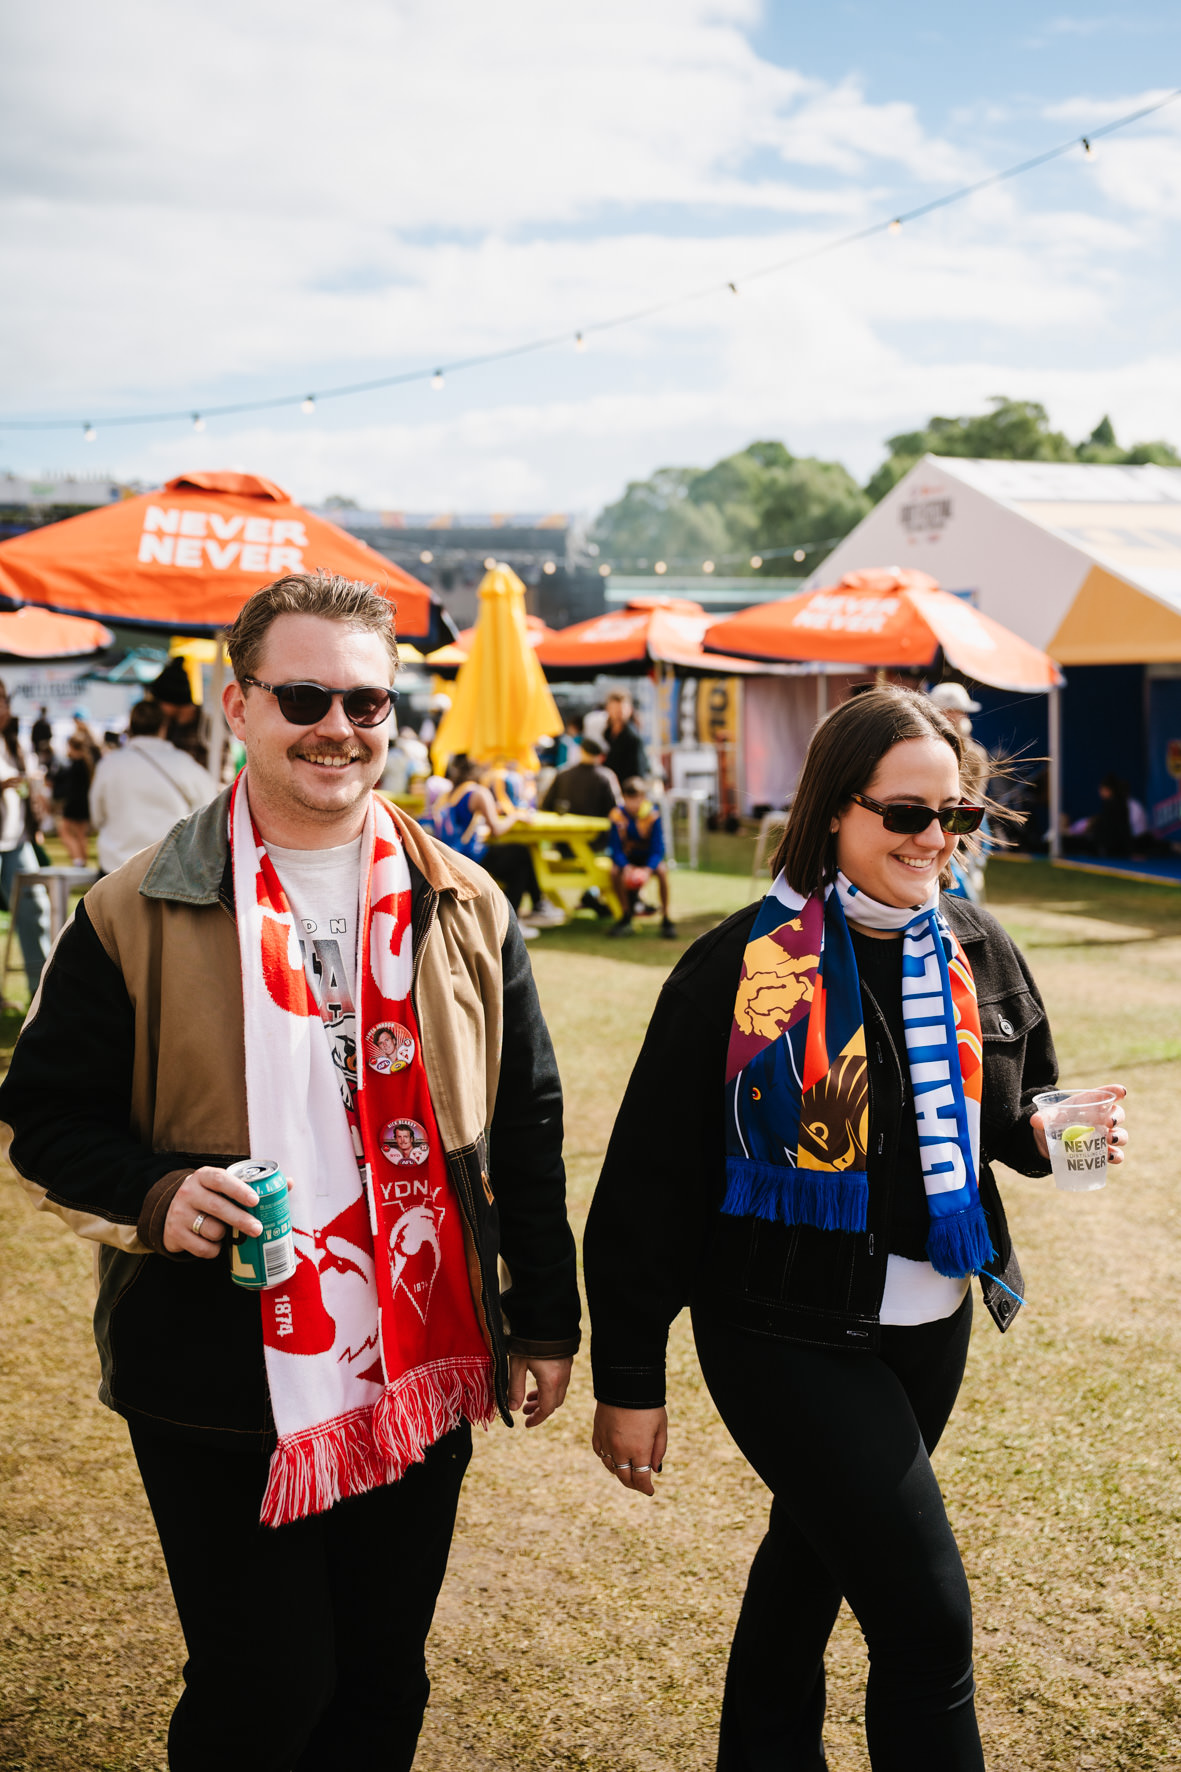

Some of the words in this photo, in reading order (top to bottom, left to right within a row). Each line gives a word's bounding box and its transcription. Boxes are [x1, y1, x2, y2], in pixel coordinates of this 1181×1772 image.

[145, 506, 308, 546] NEVER
[139, 533, 304, 573] NEVER
[1064, 1137, 1106, 1153] NEVER
[1068, 1156, 1106, 1171] NEVER
[274, 1294, 294, 1338] 1874
